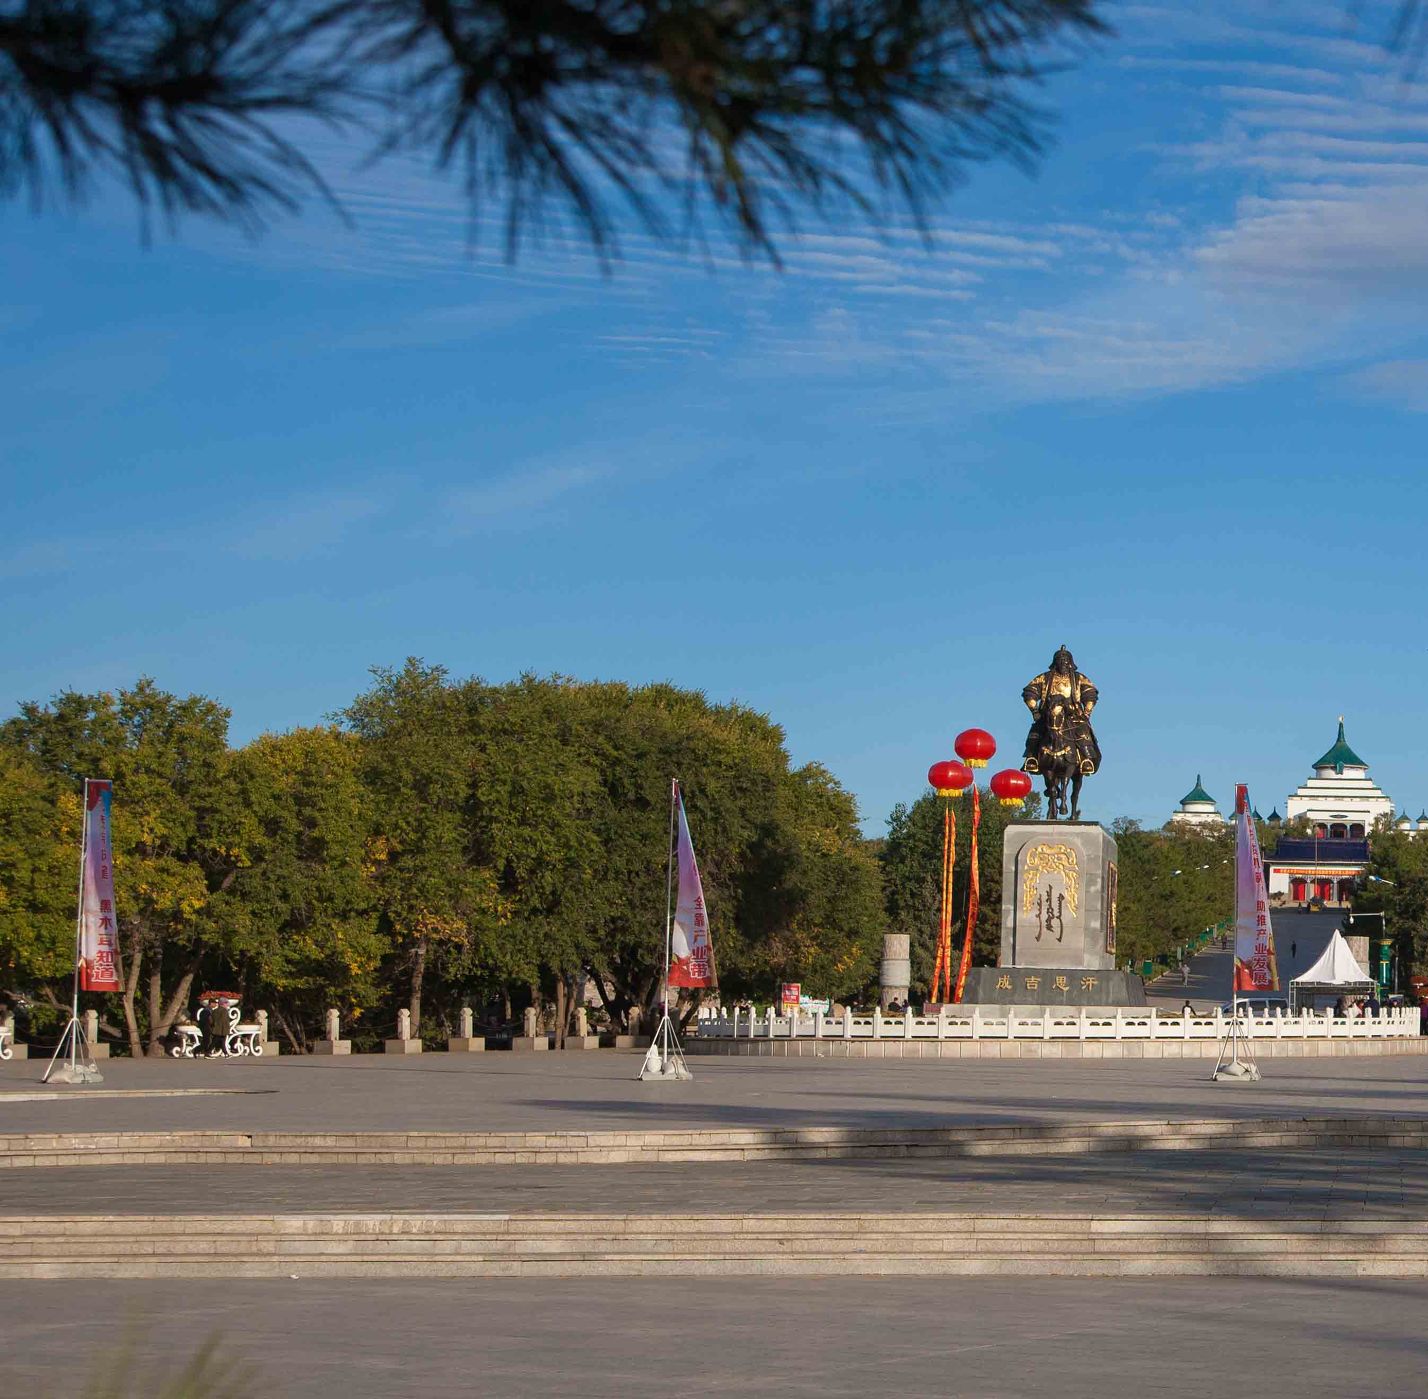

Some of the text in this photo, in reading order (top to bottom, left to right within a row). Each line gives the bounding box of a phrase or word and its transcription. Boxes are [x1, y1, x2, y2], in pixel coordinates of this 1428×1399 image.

[1253, 900, 1269, 985] 助推产业发展
[995, 974, 1098, 992] 成吉思汗
